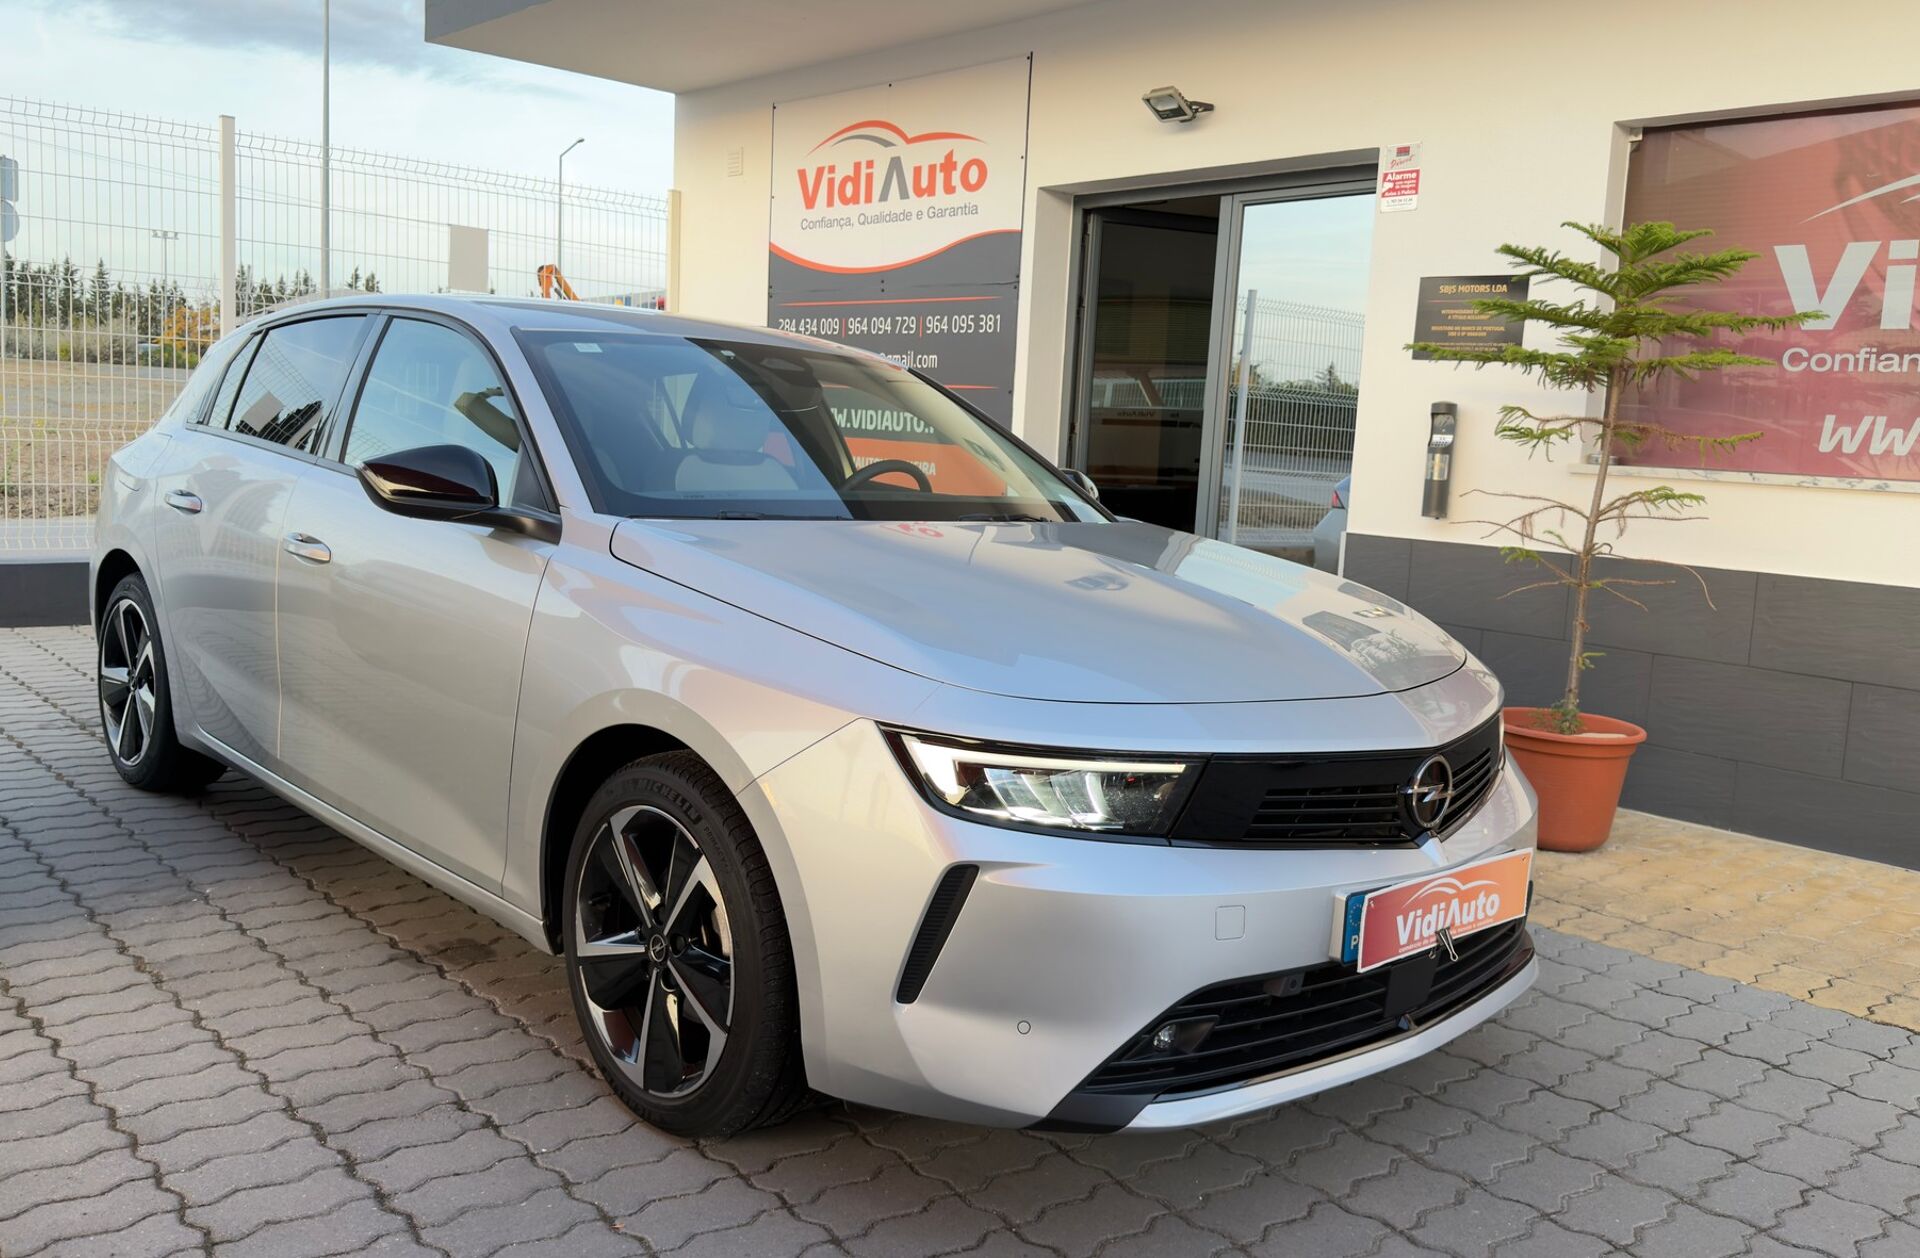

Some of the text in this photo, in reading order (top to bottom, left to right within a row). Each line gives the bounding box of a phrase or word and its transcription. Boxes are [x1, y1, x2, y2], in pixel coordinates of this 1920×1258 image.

[797, 149, 988, 210] VidiAuto
[1386, 172, 1417, 181] Alarme
[800, 202, 978, 231] Confiança, Qualidade e Garantia
[1458, 284, 1490, 293] MOTORS
[1492, 284, 1508, 293] LDA
[778, 314, 1001, 335] 284 434 009 964 094 729 964 095 381
[1396, 890, 1500, 945] VidiAuto
[1351, 935, 1359, 950] P
